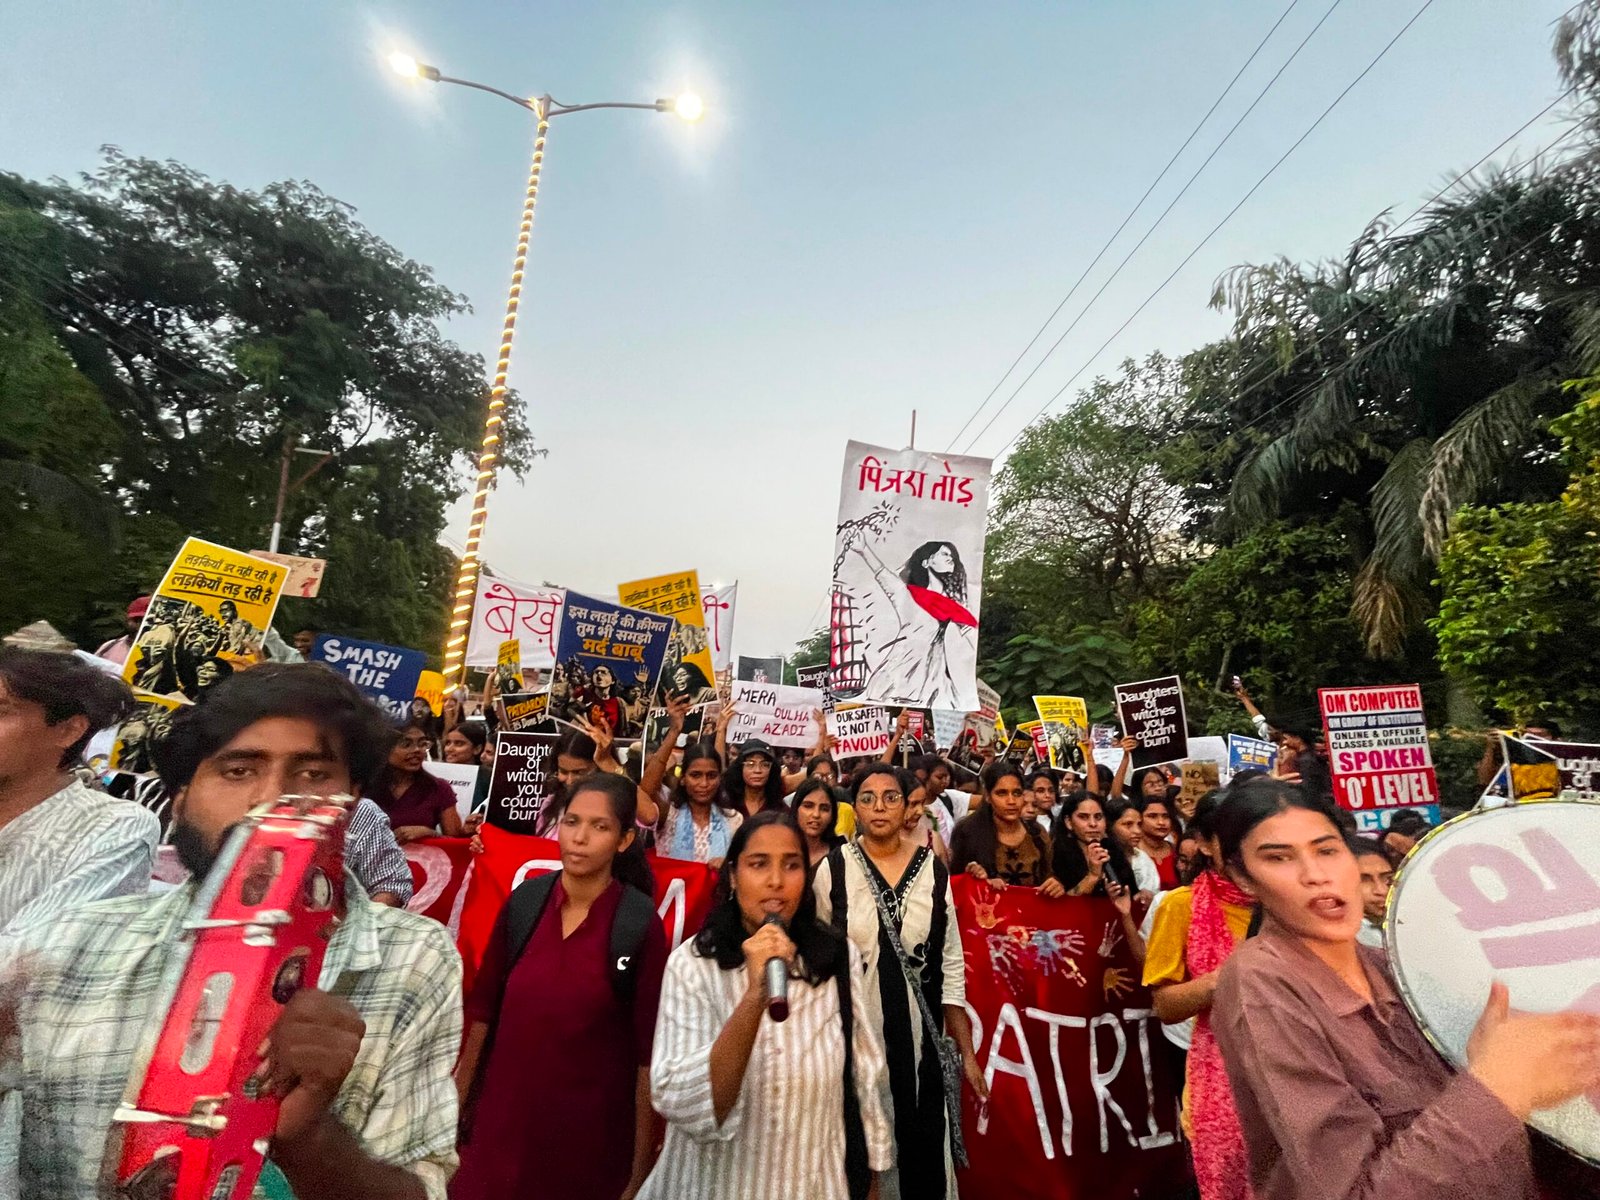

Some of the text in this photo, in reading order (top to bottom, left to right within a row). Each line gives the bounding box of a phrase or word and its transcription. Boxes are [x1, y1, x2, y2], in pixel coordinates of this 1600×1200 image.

[858, 456, 975, 508] पिंजरा तोड़
[172, 572, 274, 604] लड़कियाँ लड़ रही है
[568, 605, 588, 620] इस
[590, 610, 620, 626] लड़ाई
[620, 614, 636, 629] की
[576, 621, 596, 637] तुम
[597, 624, 614, 638] भी
[323, 639, 402, 671] SMASH
[582, 637, 646, 664] मर्द बाबू
[346, 664, 391, 689] THE
[738, 688, 776, 707] MERA
[1118, 686, 1179, 704] Daughters
[1144, 698, 1157, 709] of
[1326, 690, 1419, 713] OM COMPUTER
[737, 713, 757, 726] TOH
[836, 712, 854, 723] OUR
[1132, 706, 1176, 722] witches
[762, 722, 806, 736] AZADI
[838, 720, 882, 736] IS NOT A
[1143, 718, 1165, 730] you
[1334, 728, 1421, 740] ONLINE & OFFLINE
[835, 734, 889, 754] FAVOUR
[1332, 736, 1426, 750] CLASSES AVAILABLE
[527, 756, 542, 770] of
[1338, 748, 1425, 772] SPOKEN
[518, 784, 543, 798] you
[1371, 772, 1434, 806] LEVEL
